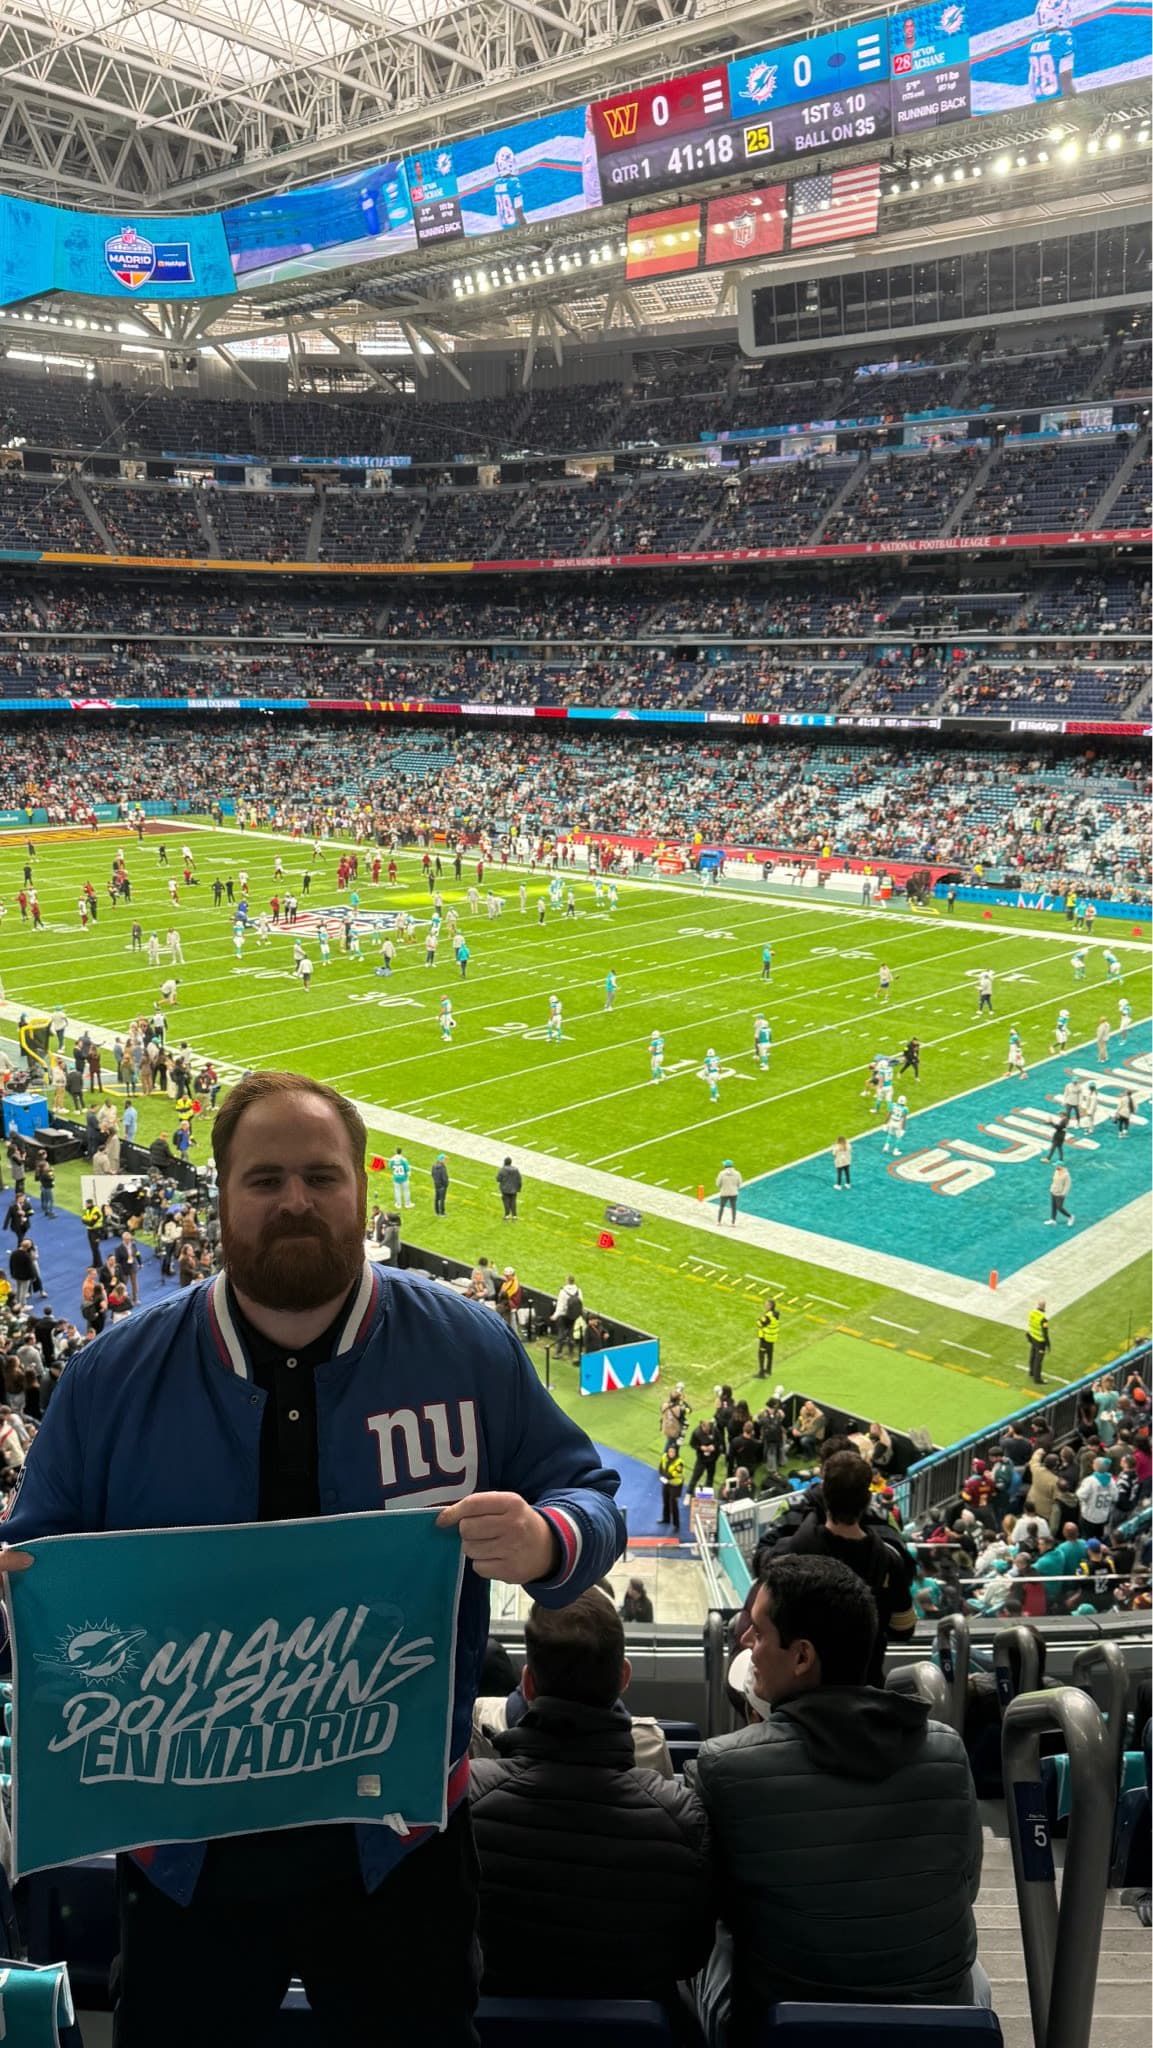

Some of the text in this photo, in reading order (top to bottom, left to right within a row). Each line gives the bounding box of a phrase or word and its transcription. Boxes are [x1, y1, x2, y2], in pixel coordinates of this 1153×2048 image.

[794, 54, 811, 87] 0
[895, 54, 912, 72] 28
[652, 95, 669, 126] 0
[801, 93, 866, 125] 1ST & 10
[898, 96, 966, 122] RUNNING BACK
[747, 127, 770, 152] 25
[795, 116, 876, 151] BALL ON 35
[611, 134, 733, 184] QTR 1 41:18
[109, 254, 152, 265] MADRID
[880, 536, 991, 552] NATIONAL FOOTBALL LEAGUE
[141, 1604, 370, 1691] MIAMI
[48, 1626, 436, 1752] DOLPHINS
[80, 1701, 399, 1785] EN MADRID
[1034, 1824, 1047, 1847] 5
